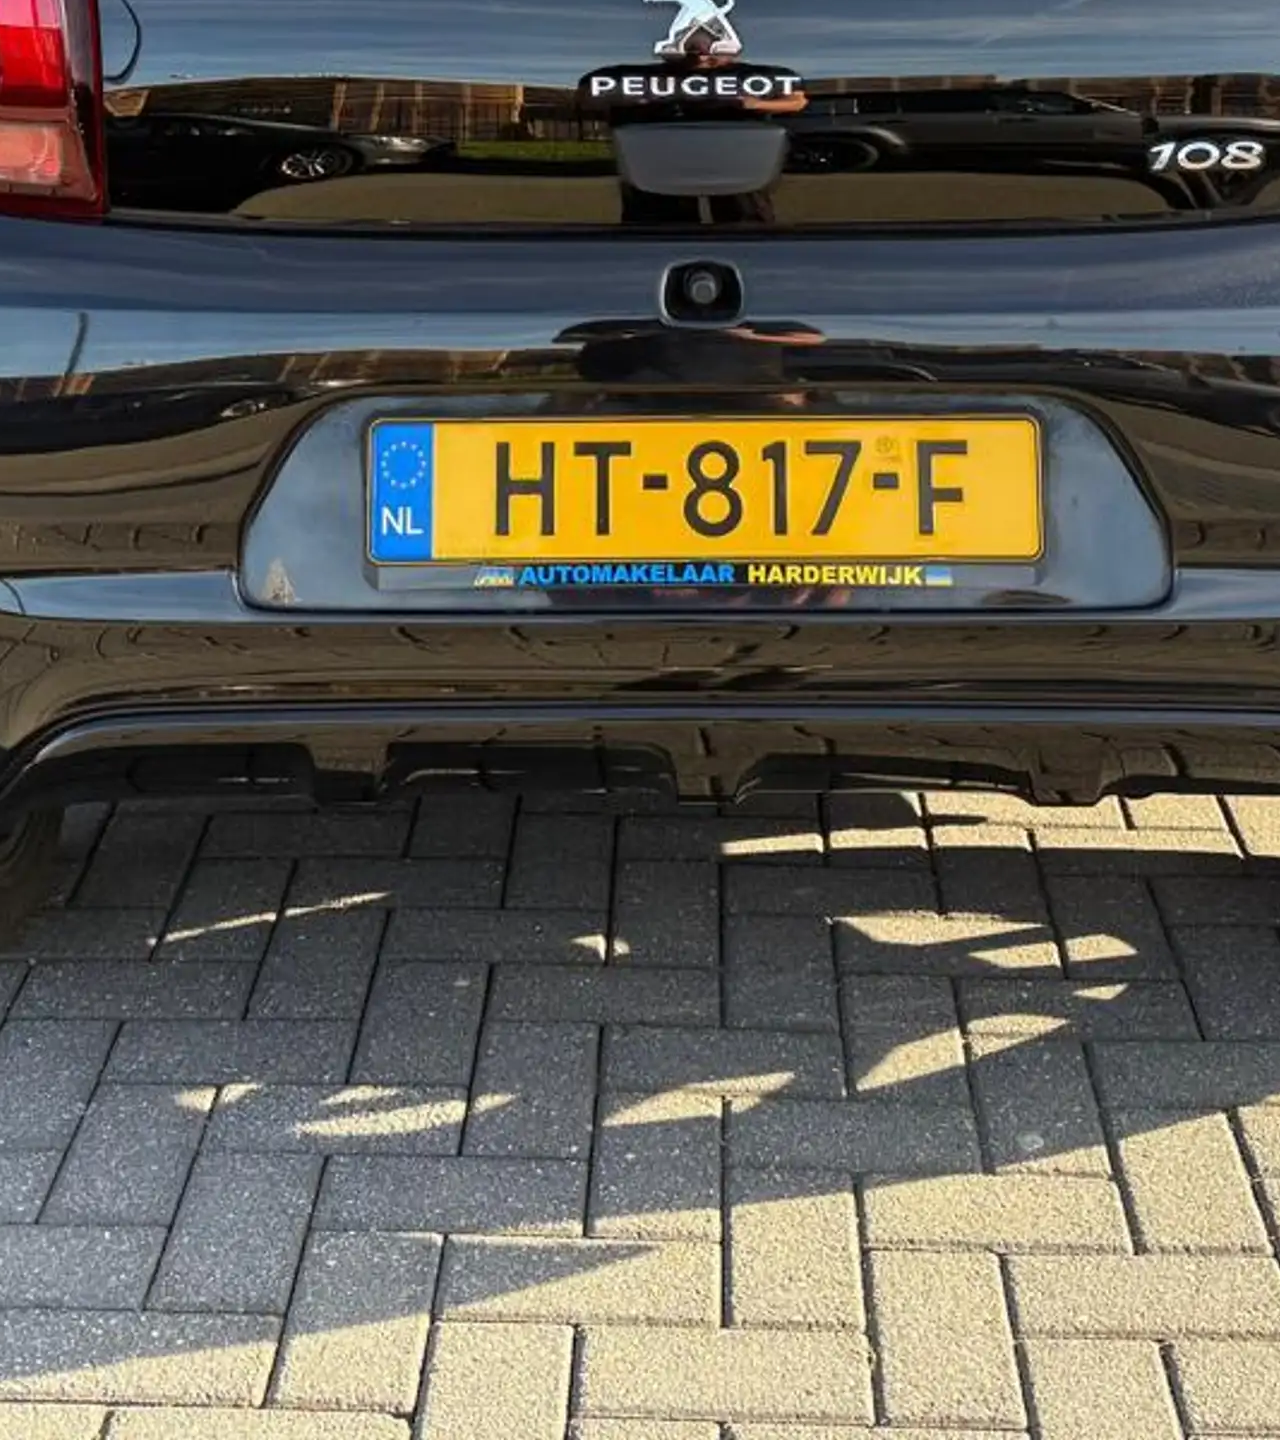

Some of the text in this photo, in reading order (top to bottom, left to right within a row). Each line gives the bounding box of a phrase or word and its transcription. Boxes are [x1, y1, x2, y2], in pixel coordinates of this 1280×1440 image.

[589, 73, 803, 99] PEUGEOT
[1147, 138, 1266, 172] 108
[381, 438, 968, 537] NL HT-817-F
[519, 564, 736, 586] AUTOMAKELAAR
[746, 564, 923, 586] HARDERWIJK
